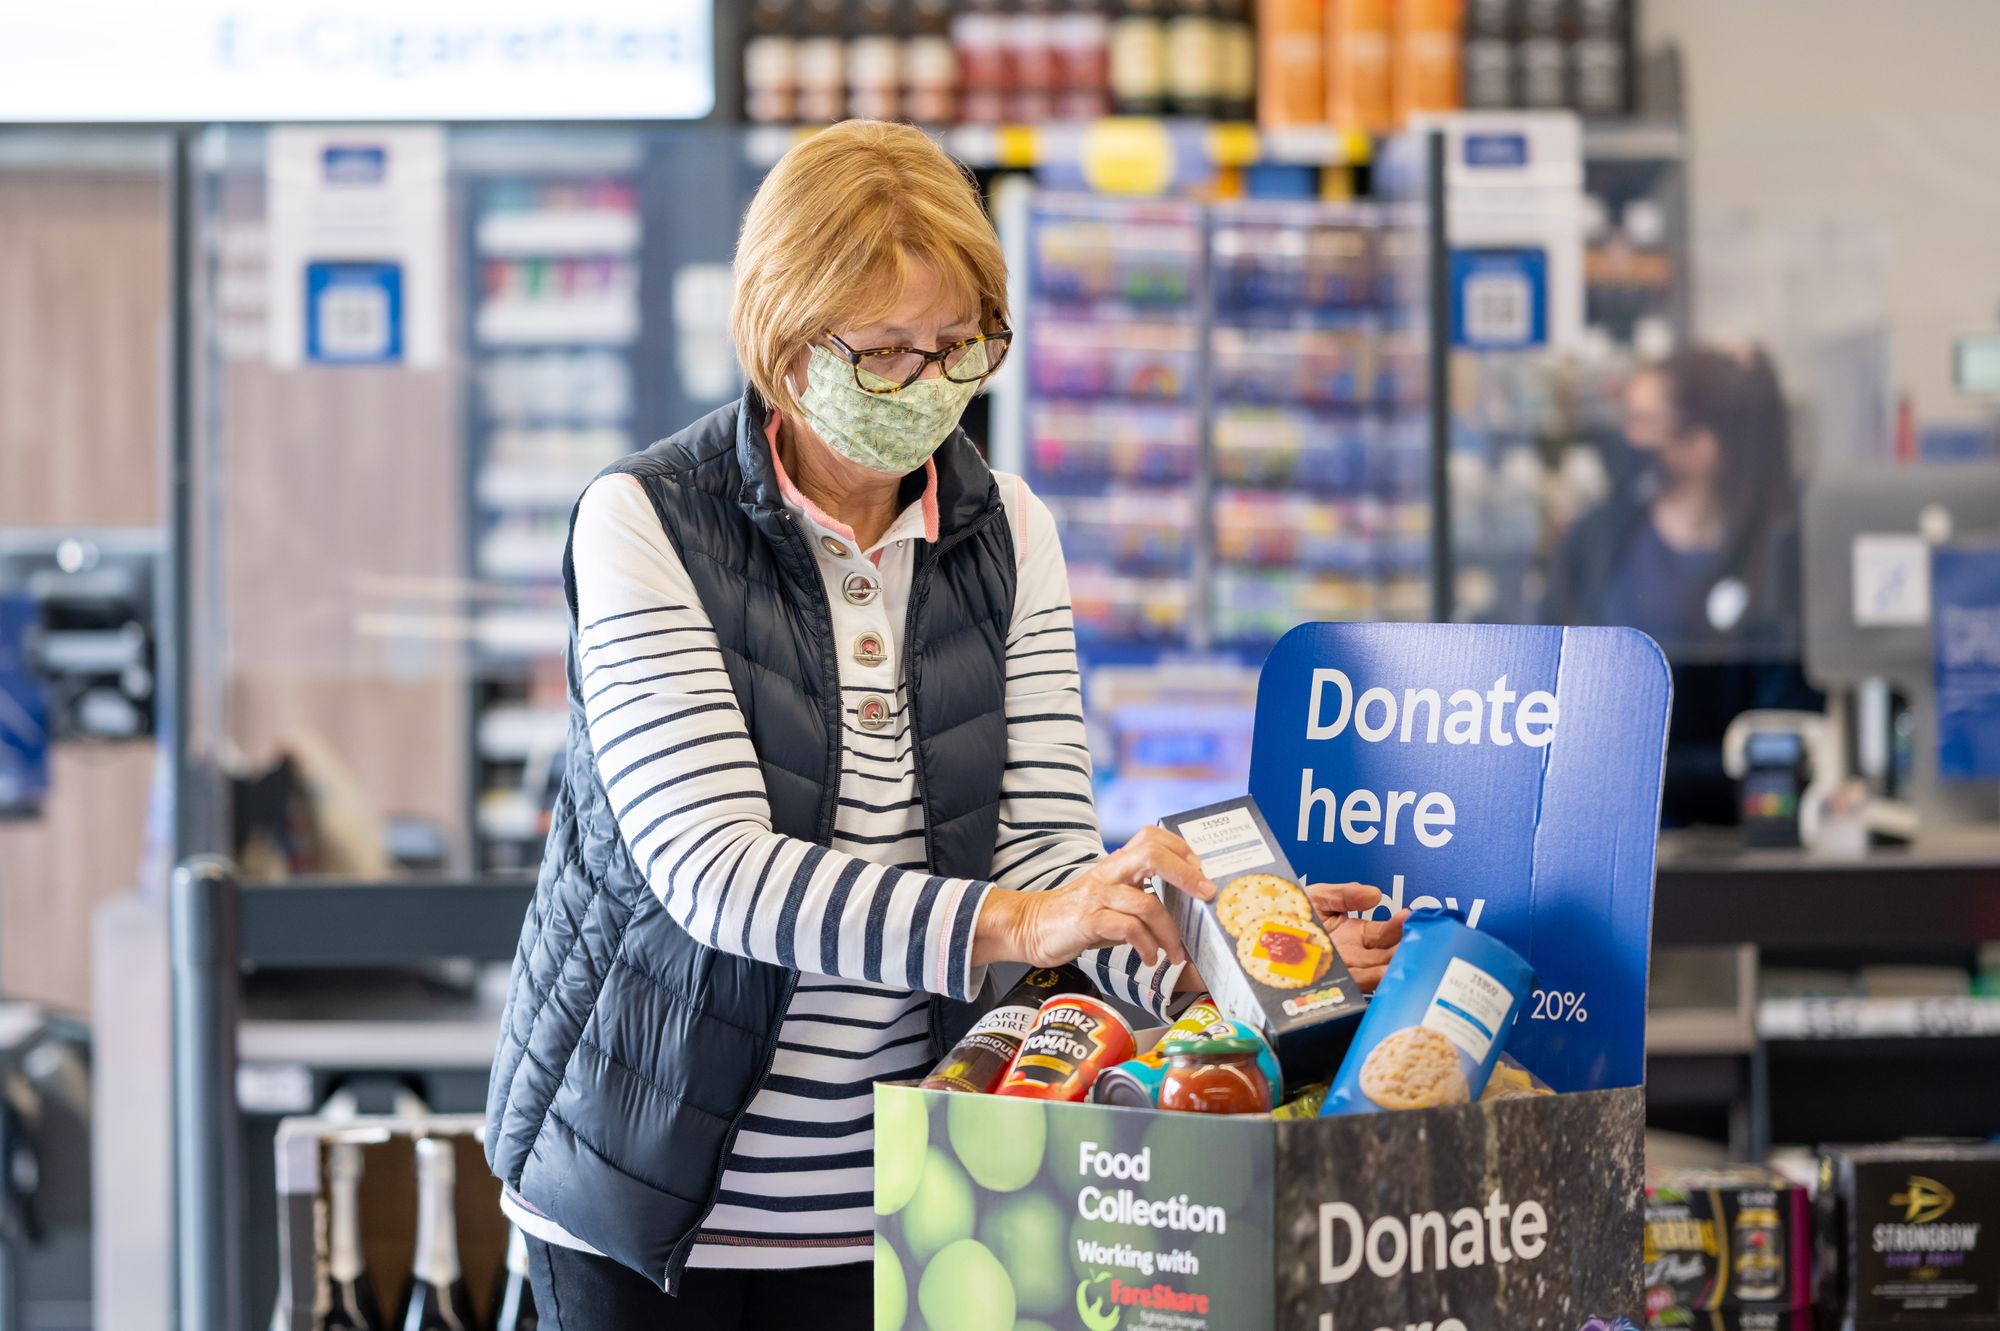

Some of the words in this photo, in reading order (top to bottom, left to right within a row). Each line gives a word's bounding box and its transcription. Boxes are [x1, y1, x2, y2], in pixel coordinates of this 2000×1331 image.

[214, 13, 698, 79] E-Cigarettes
[1306, 668, 1560, 748] Donate
[1201, 817, 1230, 829] TESCO
[1297, 768, 1456, 848] here
[1471, 974, 1499, 998] TESCO
[987, 1011, 1030, 1023] ARTE
[1042, 1008, 1096, 1033] HEINZ
[1180, 1008, 1215, 1026] EINZ
[1531, 989, 1588, 1022] 20%
[1024, 1035, 1088, 1060] TOMATO
[1079, 1141, 1151, 1182] Food
[1077, 1185, 1227, 1235] Collection
[1319, 1188, 1548, 1284] Donate
[1872, 1222, 1978, 1252] STRONGBOW
[1077, 1239, 1155, 1276] Working
[1156, 1249, 1200, 1275] with
[1110, 1279, 1210, 1315] FareShare
